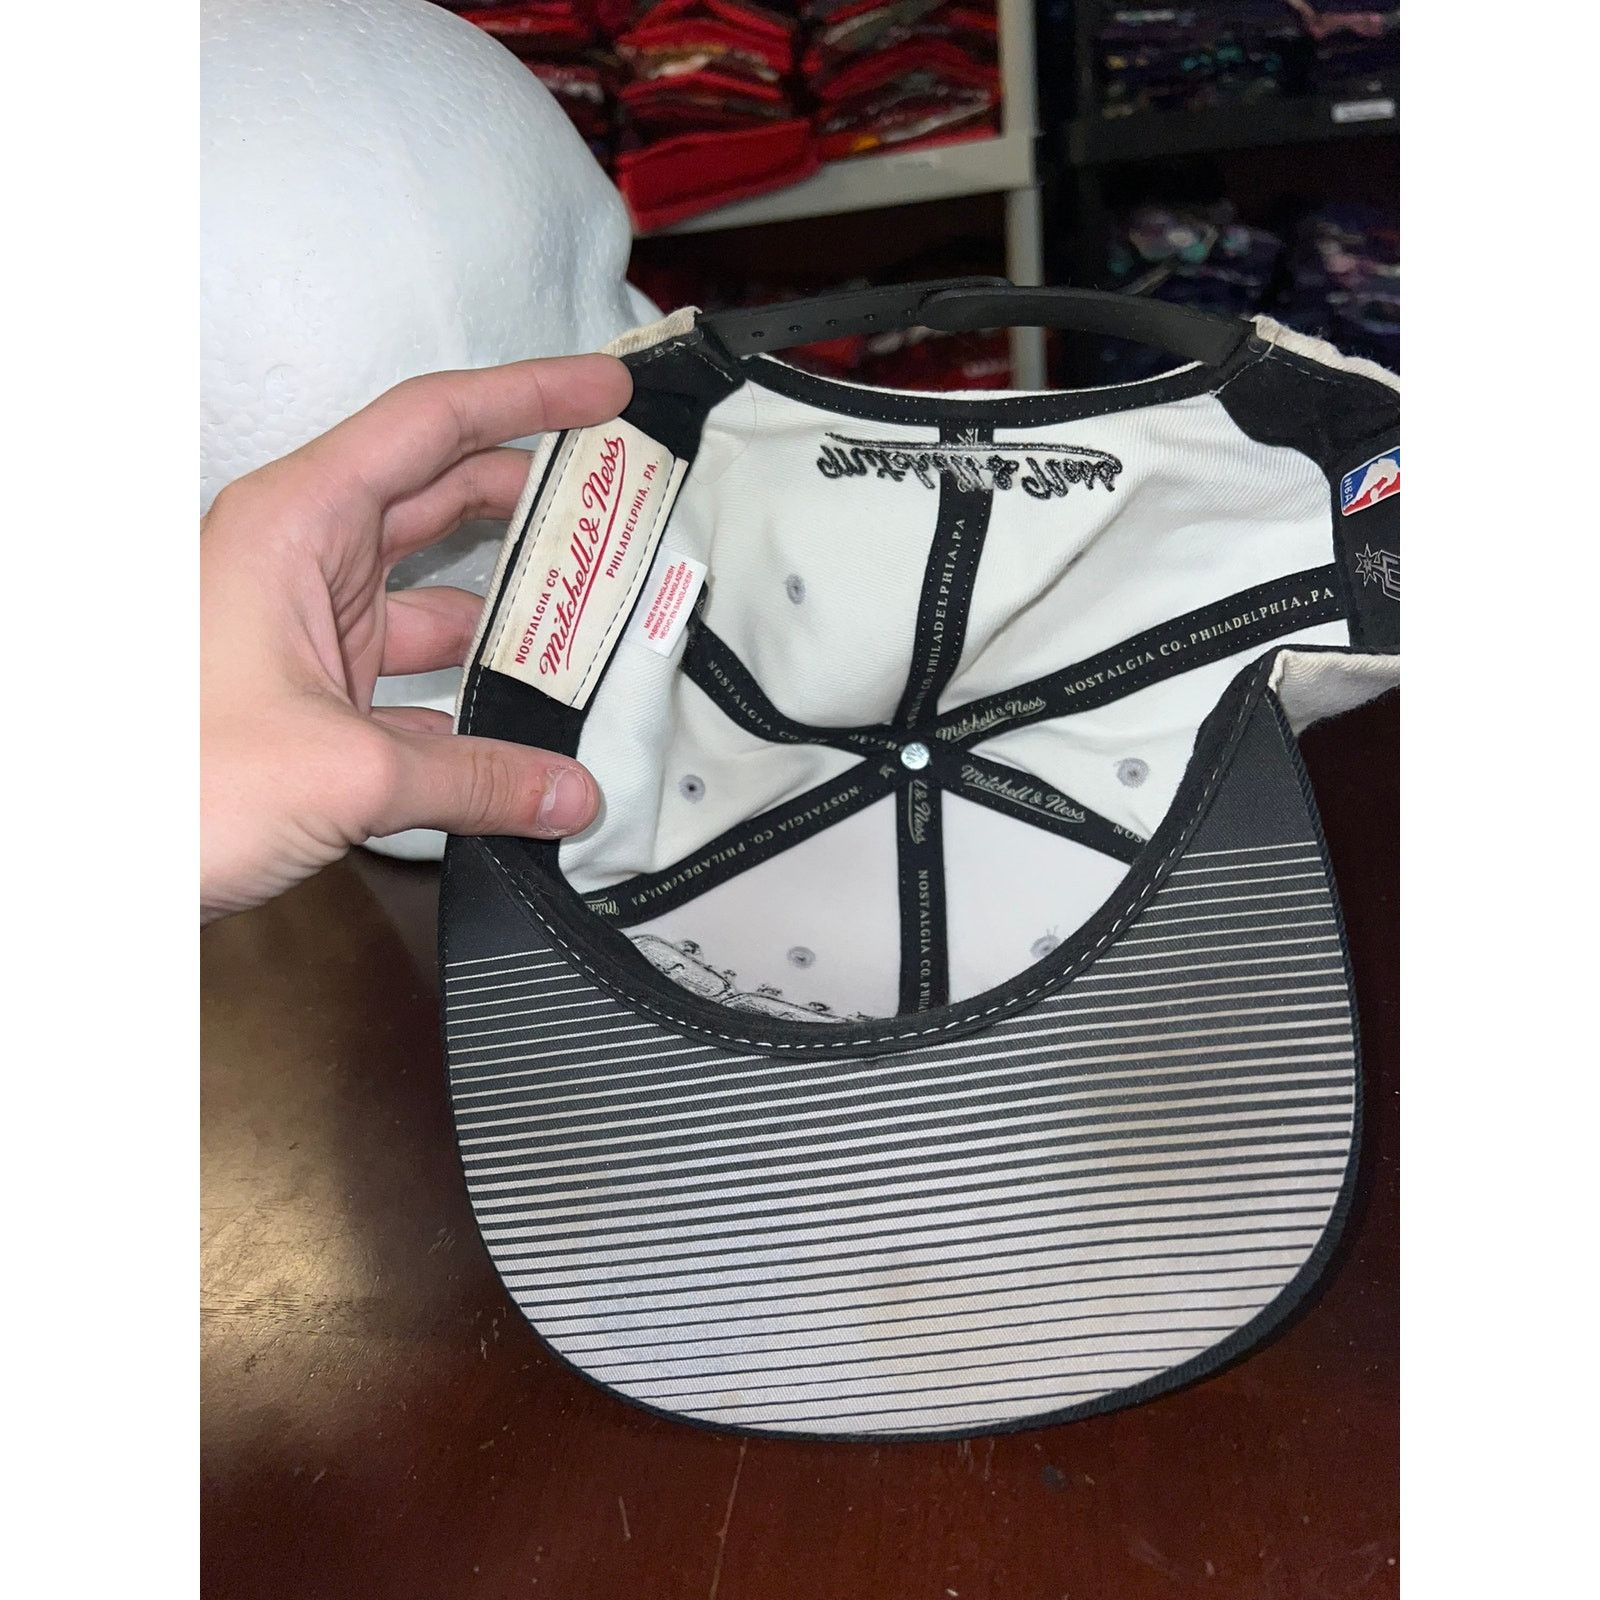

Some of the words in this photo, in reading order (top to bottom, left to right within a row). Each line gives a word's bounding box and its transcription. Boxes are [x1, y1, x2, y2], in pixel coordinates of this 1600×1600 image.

[582, 437, 626, 512] Ness
[643, 459, 660, 481] PA.
[1343, 477, 1354, 503] NBA
[578, 517, 600, 545] &
[515, 592, 551, 664] NOSTALGIA
[547, 567, 562, 588] CO.
[539, 532, 594, 675] Mitchell
[644, 611, 656, 629] MADE
[655, 565, 676, 605] BANGLADESH
[659, 618, 673, 639] HECHO
[669, 610, 677, 619] EN
[673, 569, 693, 610] BANGLADESH
[663, 600, 671, 610] AU
[667, 561, 687, 601] BANGLADESH
[707, 660, 771, 731] NOSTALGIA
[935, 709, 997, 741] Mitchell
[1005, 696, 1046, 716] Ness
[1064, 652, 1156, 696] NOSTALGIA
[1159, 638, 1187, 655] CO.
[777, 786, 862, 832] NOSTALGIA
[961, 764, 1033, 801] Mitchell
[1029, 791, 1044, 805] &
[1046, 794, 1086, 821] Ness
[748, 829, 774, 845] CO.
[913, 802, 931, 844] Ness
[918, 869, 931, 954] NOSTALGIA
